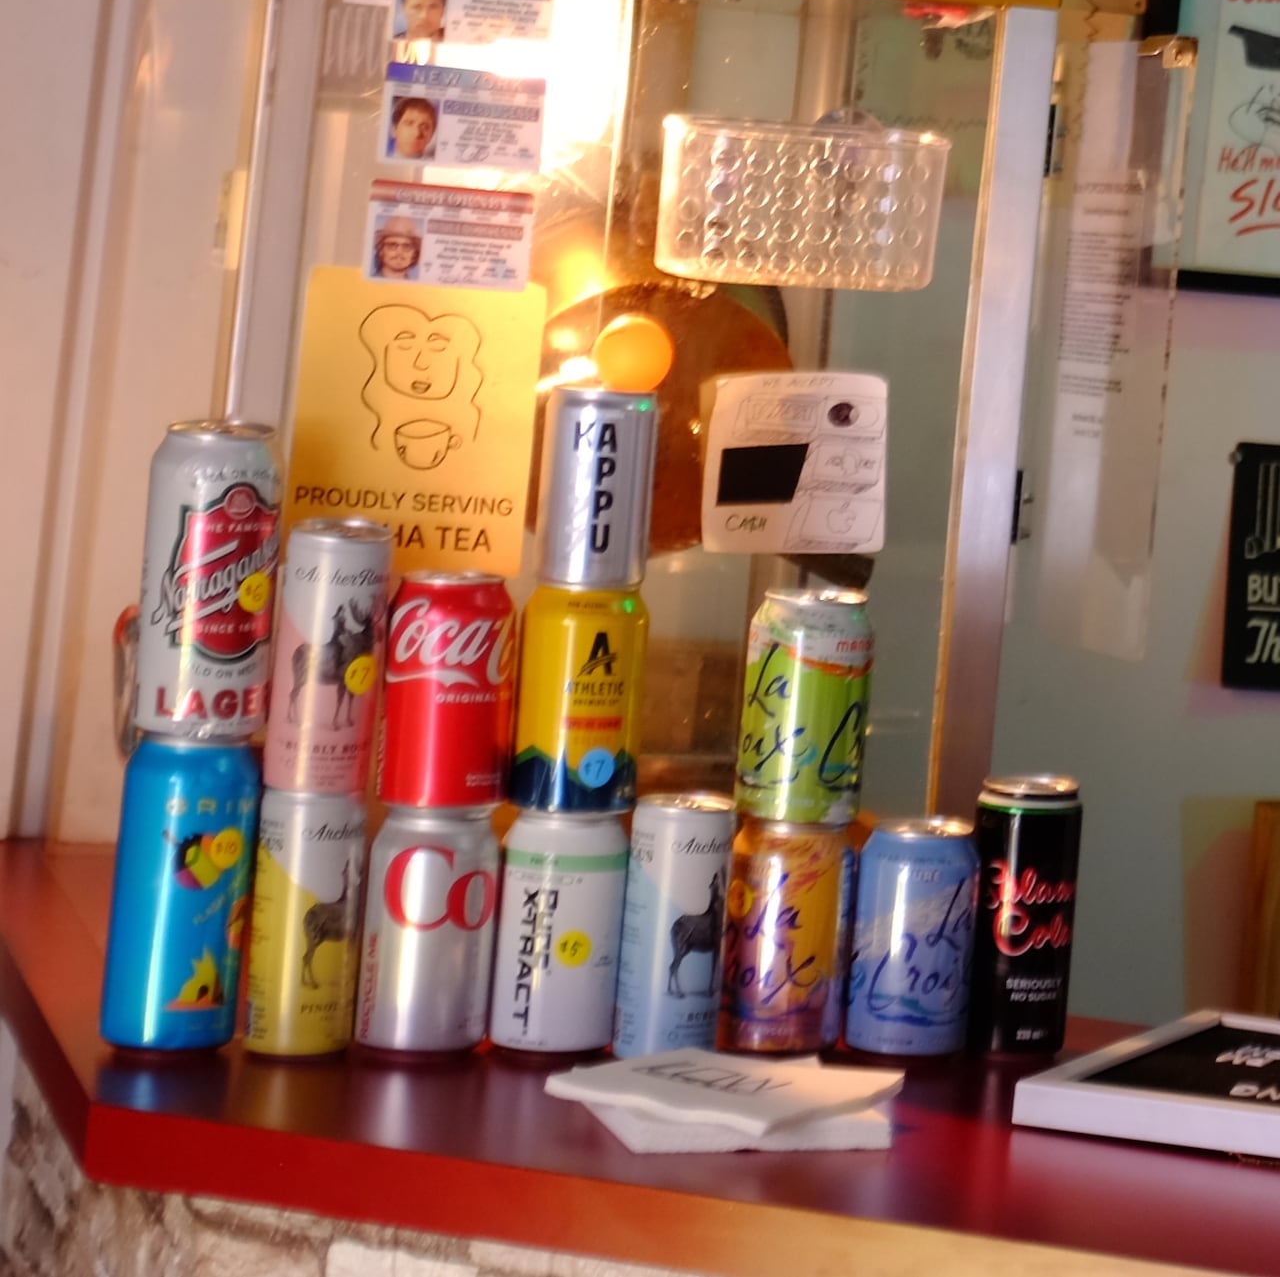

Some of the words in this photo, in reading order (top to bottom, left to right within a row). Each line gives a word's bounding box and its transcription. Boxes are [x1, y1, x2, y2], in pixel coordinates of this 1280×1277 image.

[413, 69, 459, 86] NEW
[294, 485, 405, 510] PROUDLY
[412, 492, 514, 517] SERVING
[435, 526, 492, 553] TEA
[565, 680, 625, 697] ATHLETIC
[435, 691, 496, 704] ORIGINAL
[1010, 991, 1026, 1002] NO
